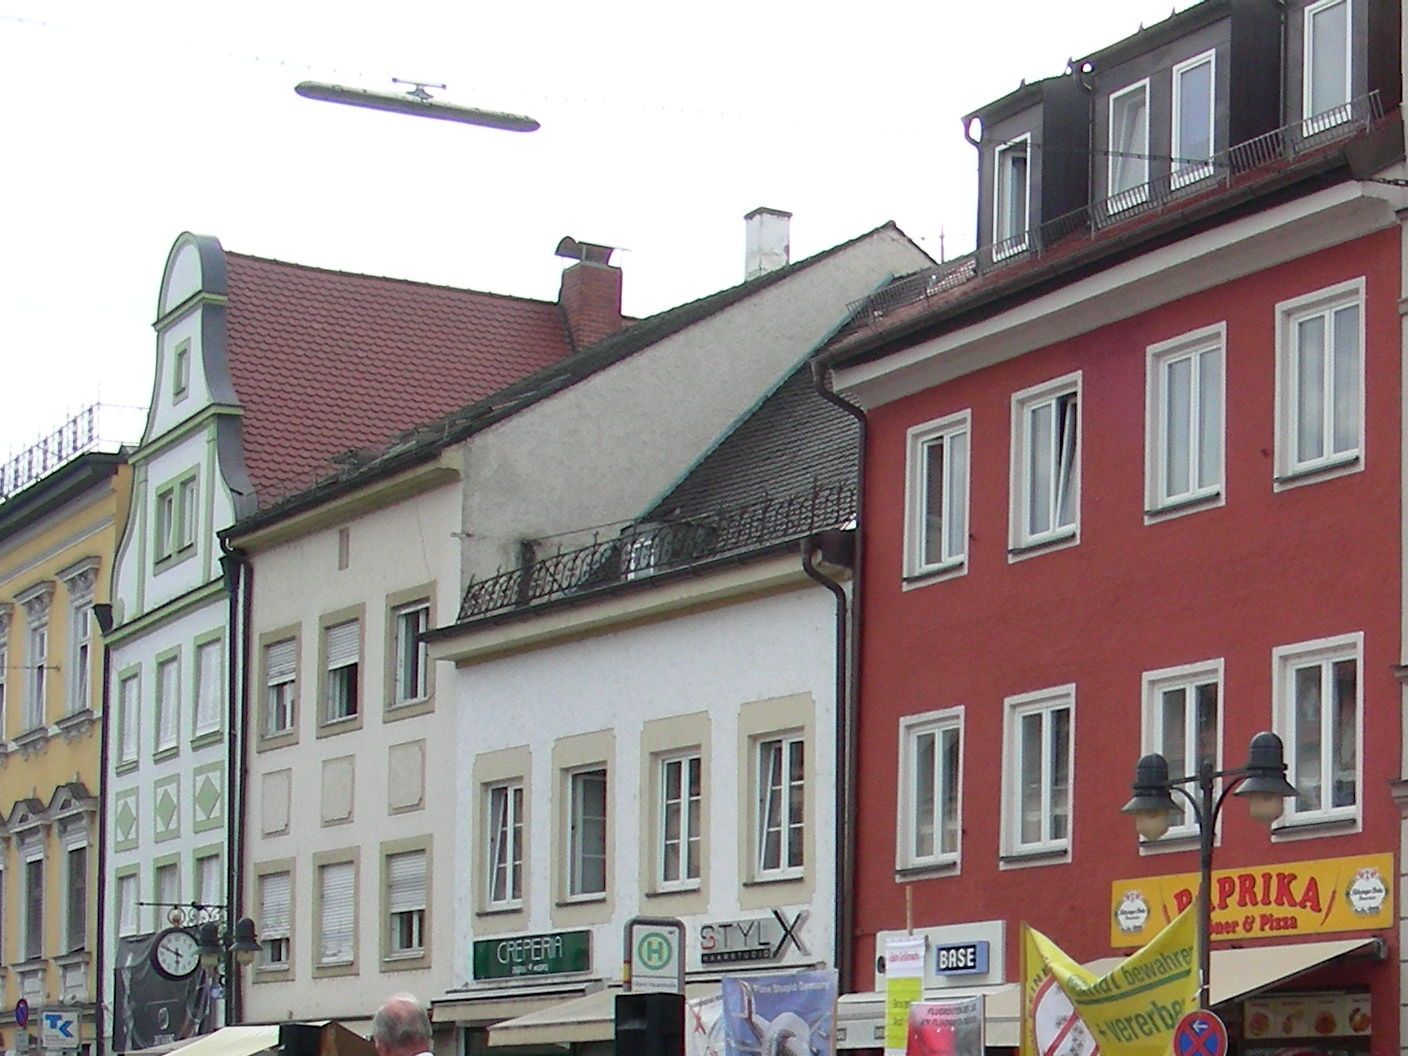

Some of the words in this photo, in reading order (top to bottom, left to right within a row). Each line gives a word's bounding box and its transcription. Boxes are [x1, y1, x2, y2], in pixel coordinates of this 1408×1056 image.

[1174, 872, 1322, 914] PPRIKA
[1259, 913, 1297, 932] Pizza
[647, 941, 664, 962] H
[940, 947, 975, 969] BASE
